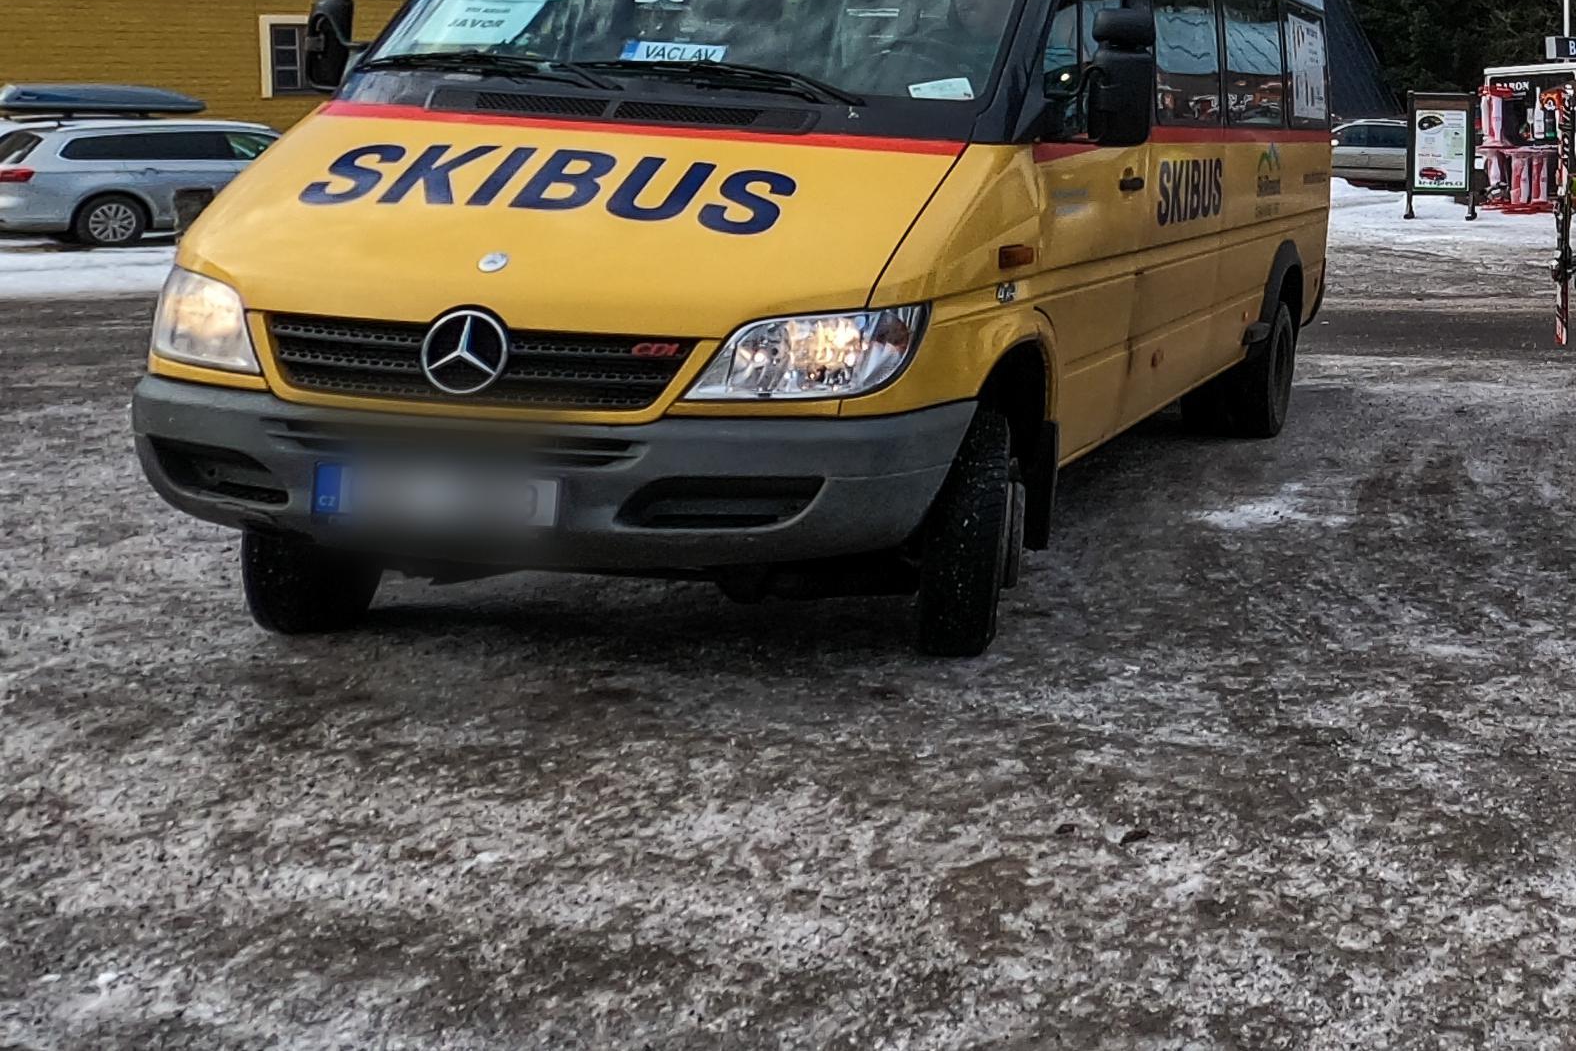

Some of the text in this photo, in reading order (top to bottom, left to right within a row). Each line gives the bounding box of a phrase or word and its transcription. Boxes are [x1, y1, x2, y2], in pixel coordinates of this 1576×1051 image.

[297, 143, 798, 236] SKIBUS
[1156, 157, 1223, 227] SKIBUS
[631, 342, 680, 358] CDI
